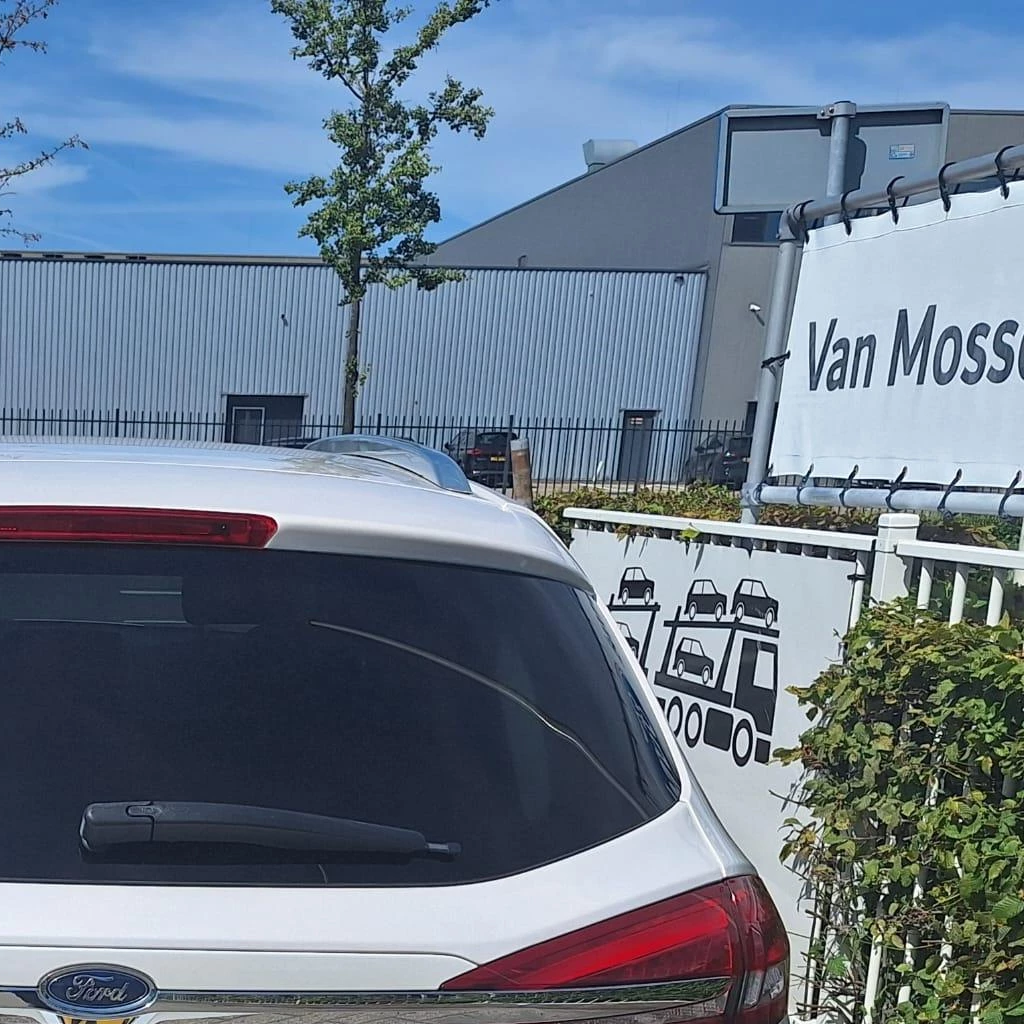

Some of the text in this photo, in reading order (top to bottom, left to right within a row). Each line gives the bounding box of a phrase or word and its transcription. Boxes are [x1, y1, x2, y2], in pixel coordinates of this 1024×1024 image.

[809, 304, 1024, 392] Van Moss
[66, 974, 129, 1001] Ford
